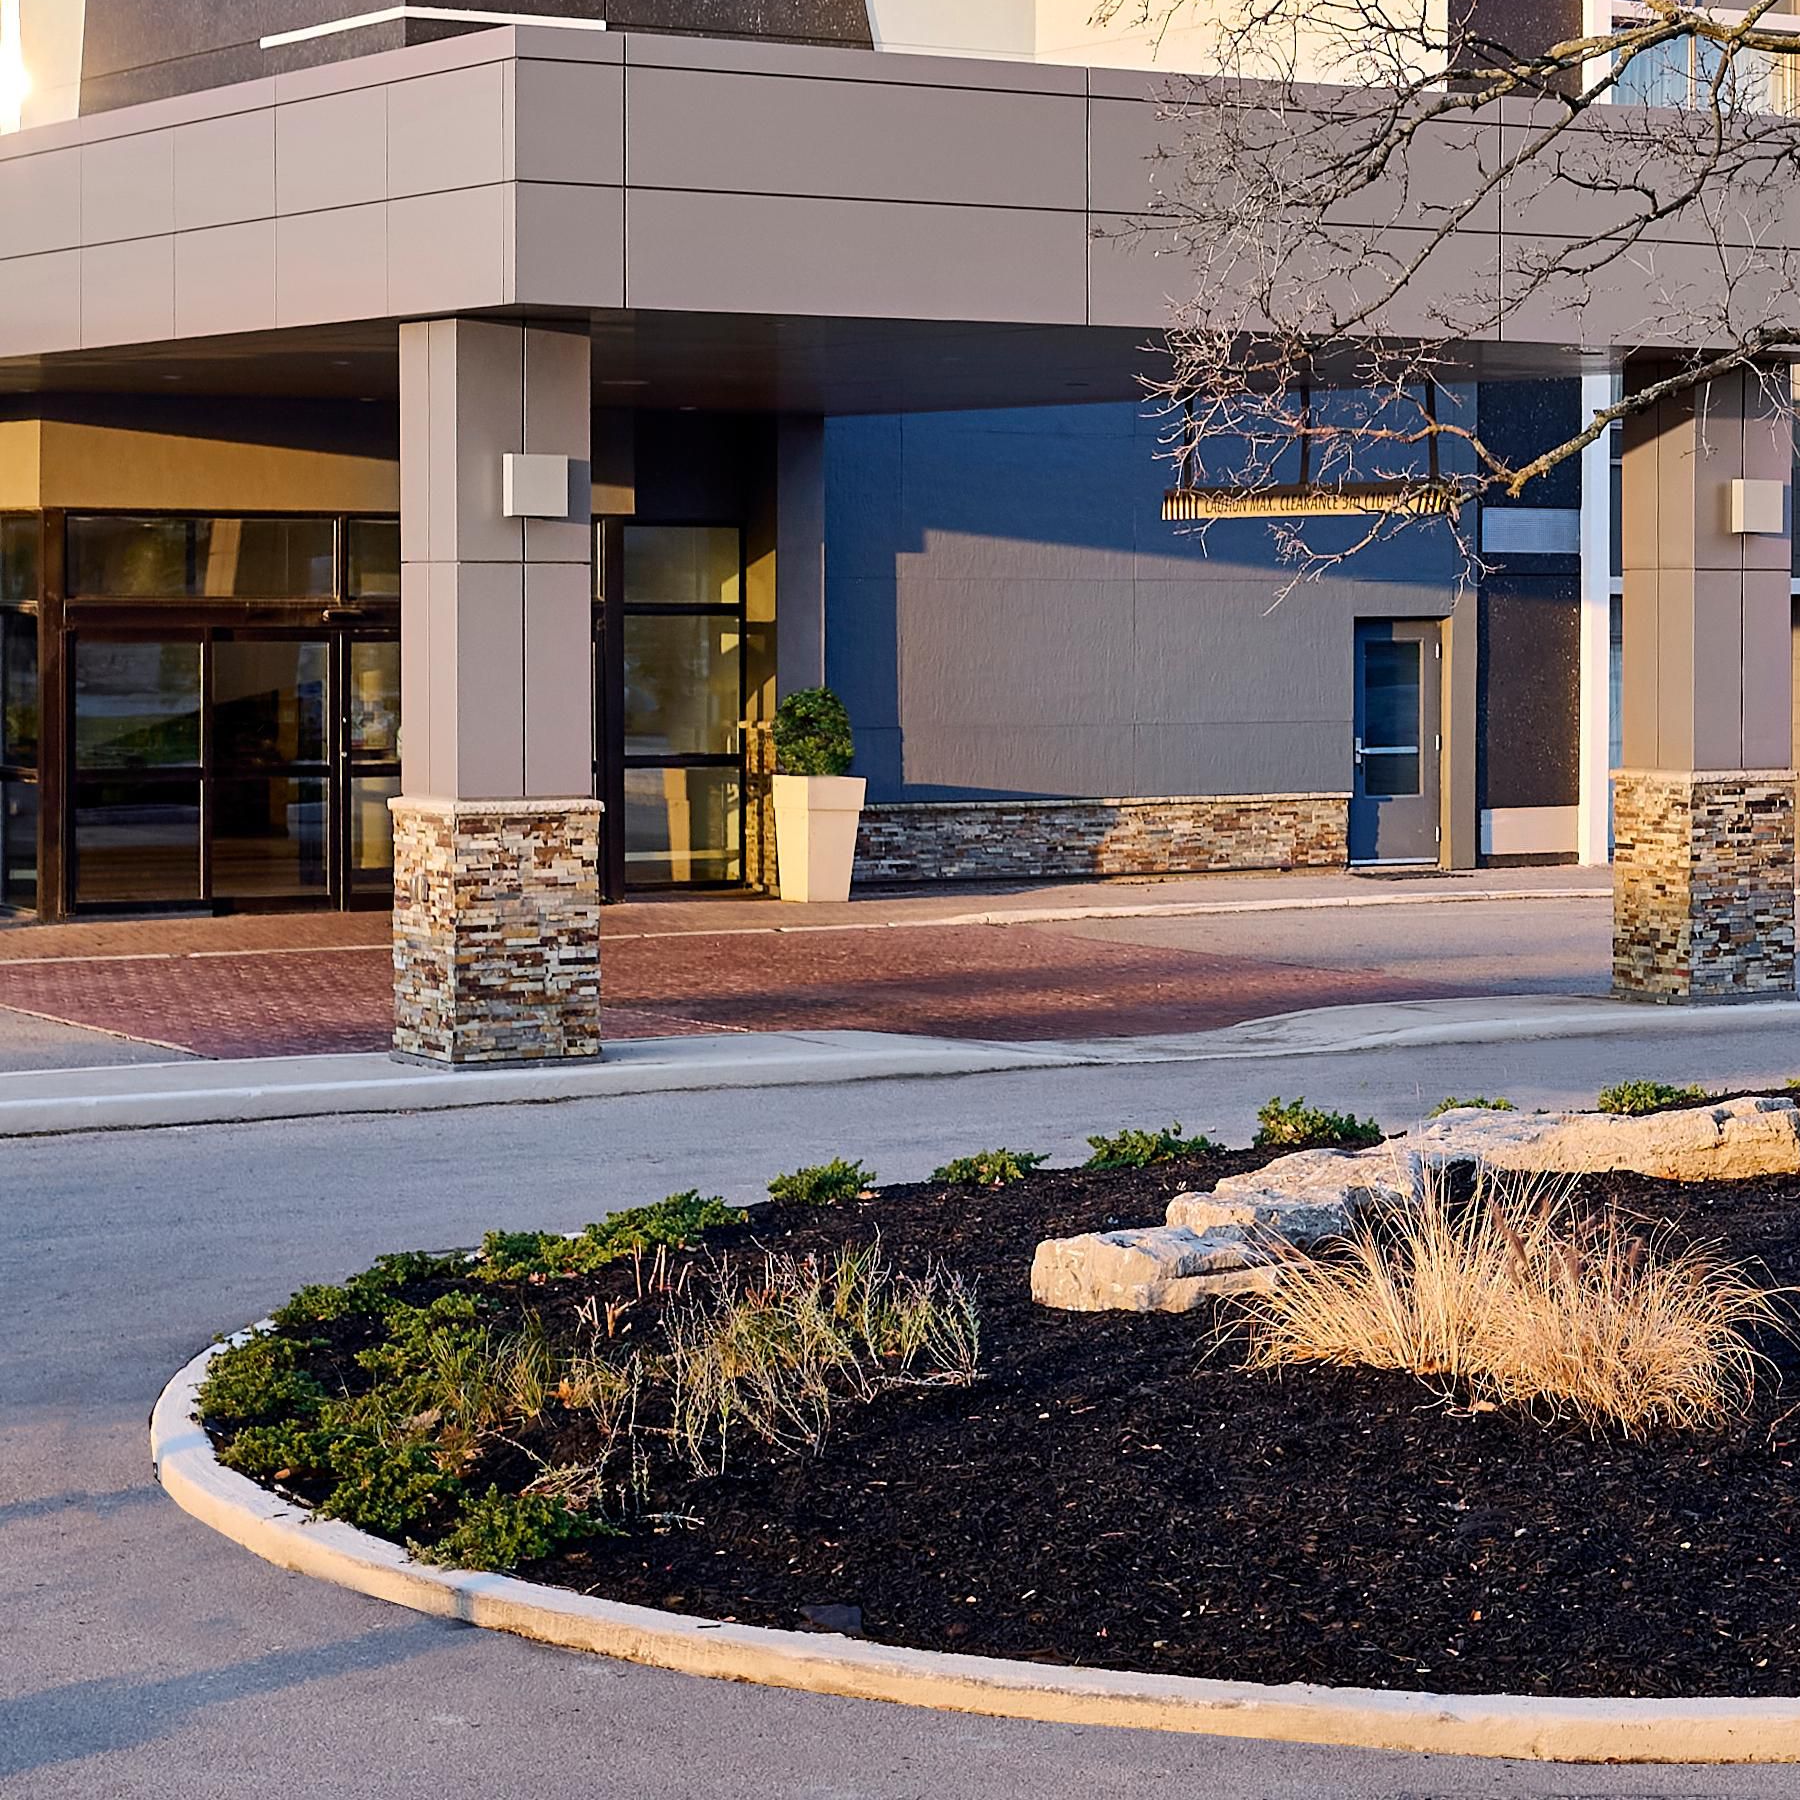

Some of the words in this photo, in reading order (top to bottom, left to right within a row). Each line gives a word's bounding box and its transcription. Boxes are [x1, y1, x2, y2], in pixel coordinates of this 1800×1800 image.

[1250, 495, 1276, 512] MAX.
[1280, 493, 1338, 511] CLEARANCE
[1342, 493, 1360, 510] 3m
